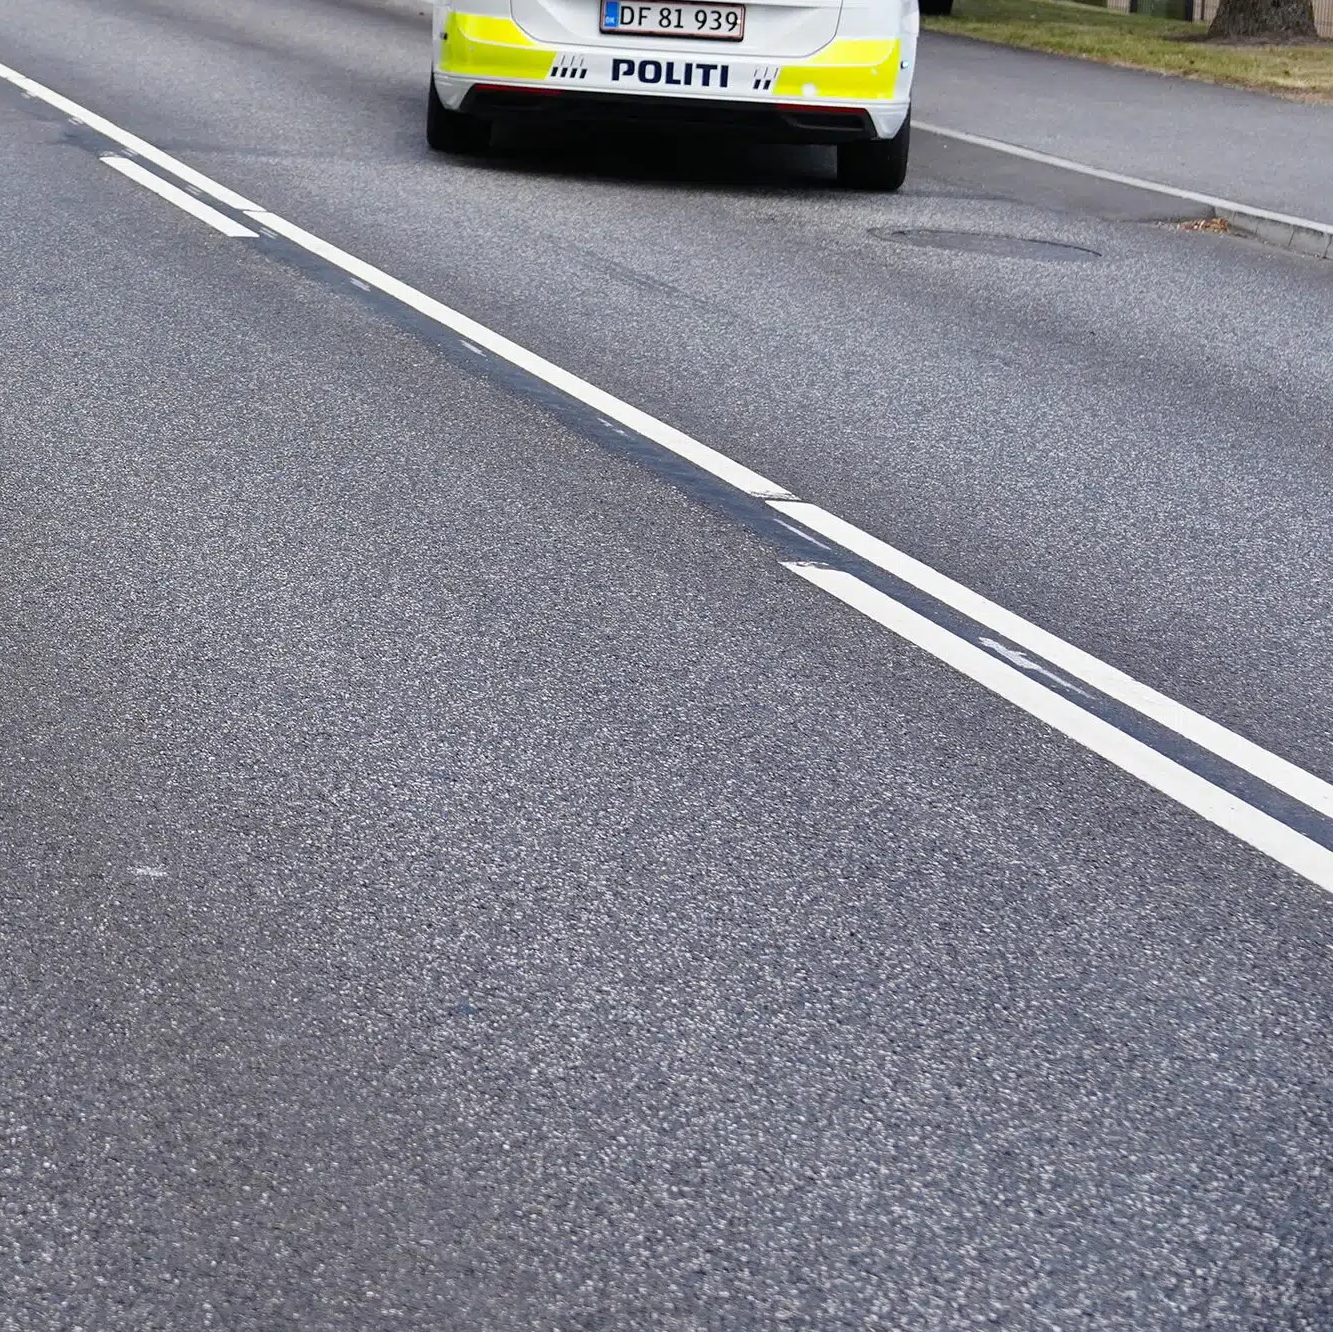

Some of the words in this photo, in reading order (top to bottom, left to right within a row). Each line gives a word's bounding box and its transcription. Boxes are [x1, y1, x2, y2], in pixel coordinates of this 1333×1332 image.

[620, 6, 651, 26] DF
[658, 7, 684, 28] 81
[694, 9, 739, 32] 939
[611, 58, 729, 88] POLITI
